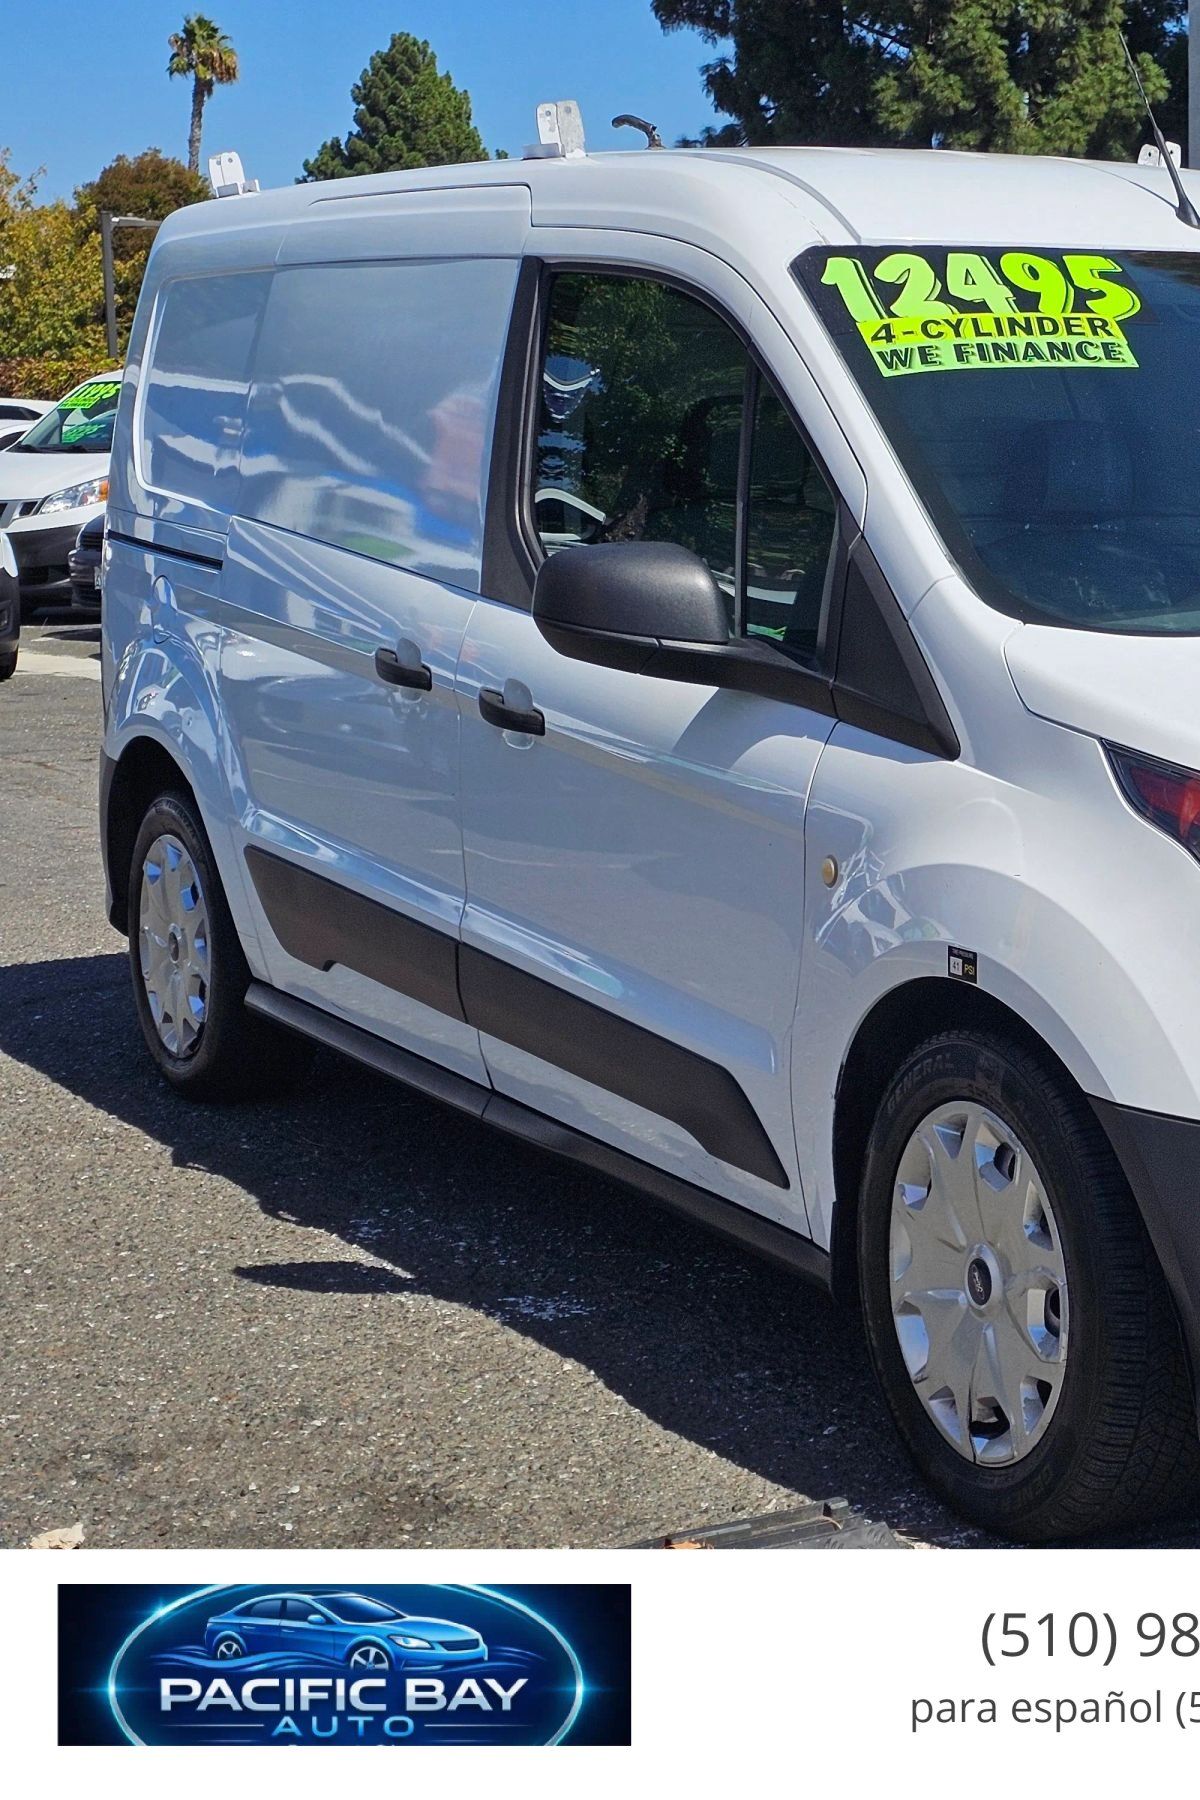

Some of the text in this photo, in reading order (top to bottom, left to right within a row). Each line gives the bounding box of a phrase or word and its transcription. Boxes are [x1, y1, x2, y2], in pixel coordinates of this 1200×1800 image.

[820, 252, 1142, 322] 12495
[870, 316, 1114, 345] 4-CYLINDER
[877, 341, 1130, 370] WE FINANCE
